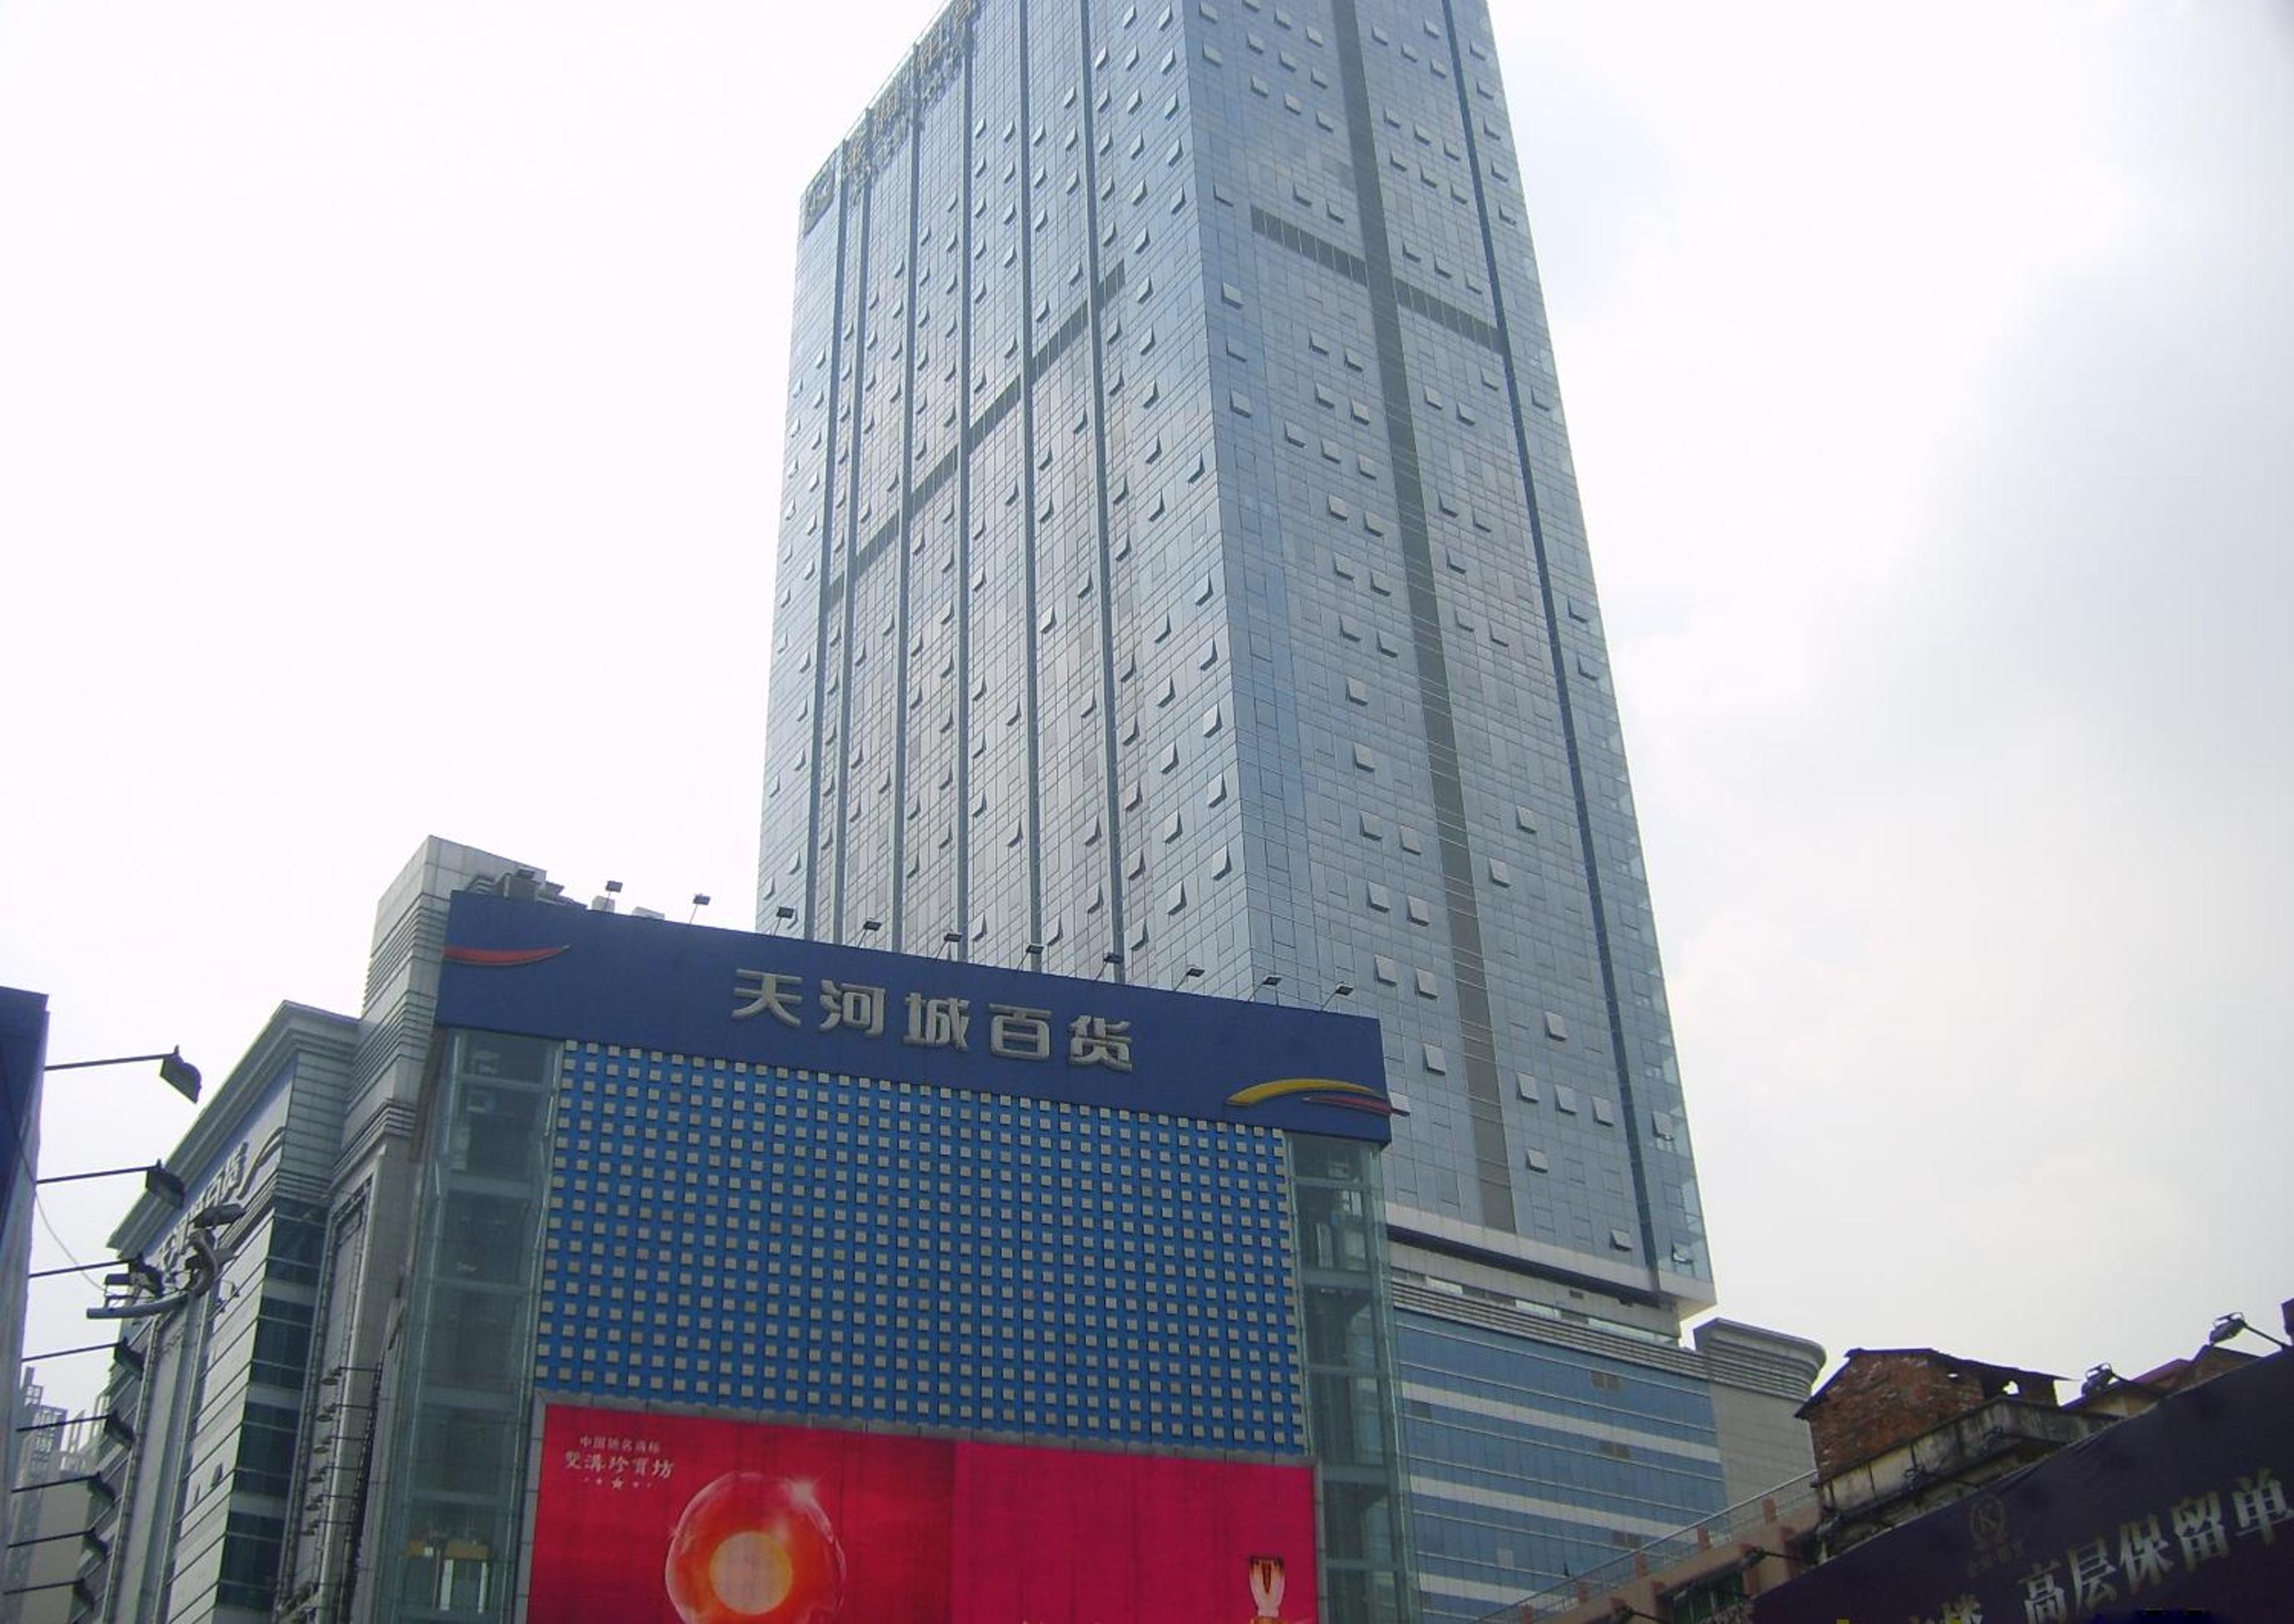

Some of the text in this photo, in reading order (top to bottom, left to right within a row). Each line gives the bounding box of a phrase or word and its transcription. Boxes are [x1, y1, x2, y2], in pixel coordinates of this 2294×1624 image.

[731, 968, 1135, 1073] 天河城百货
